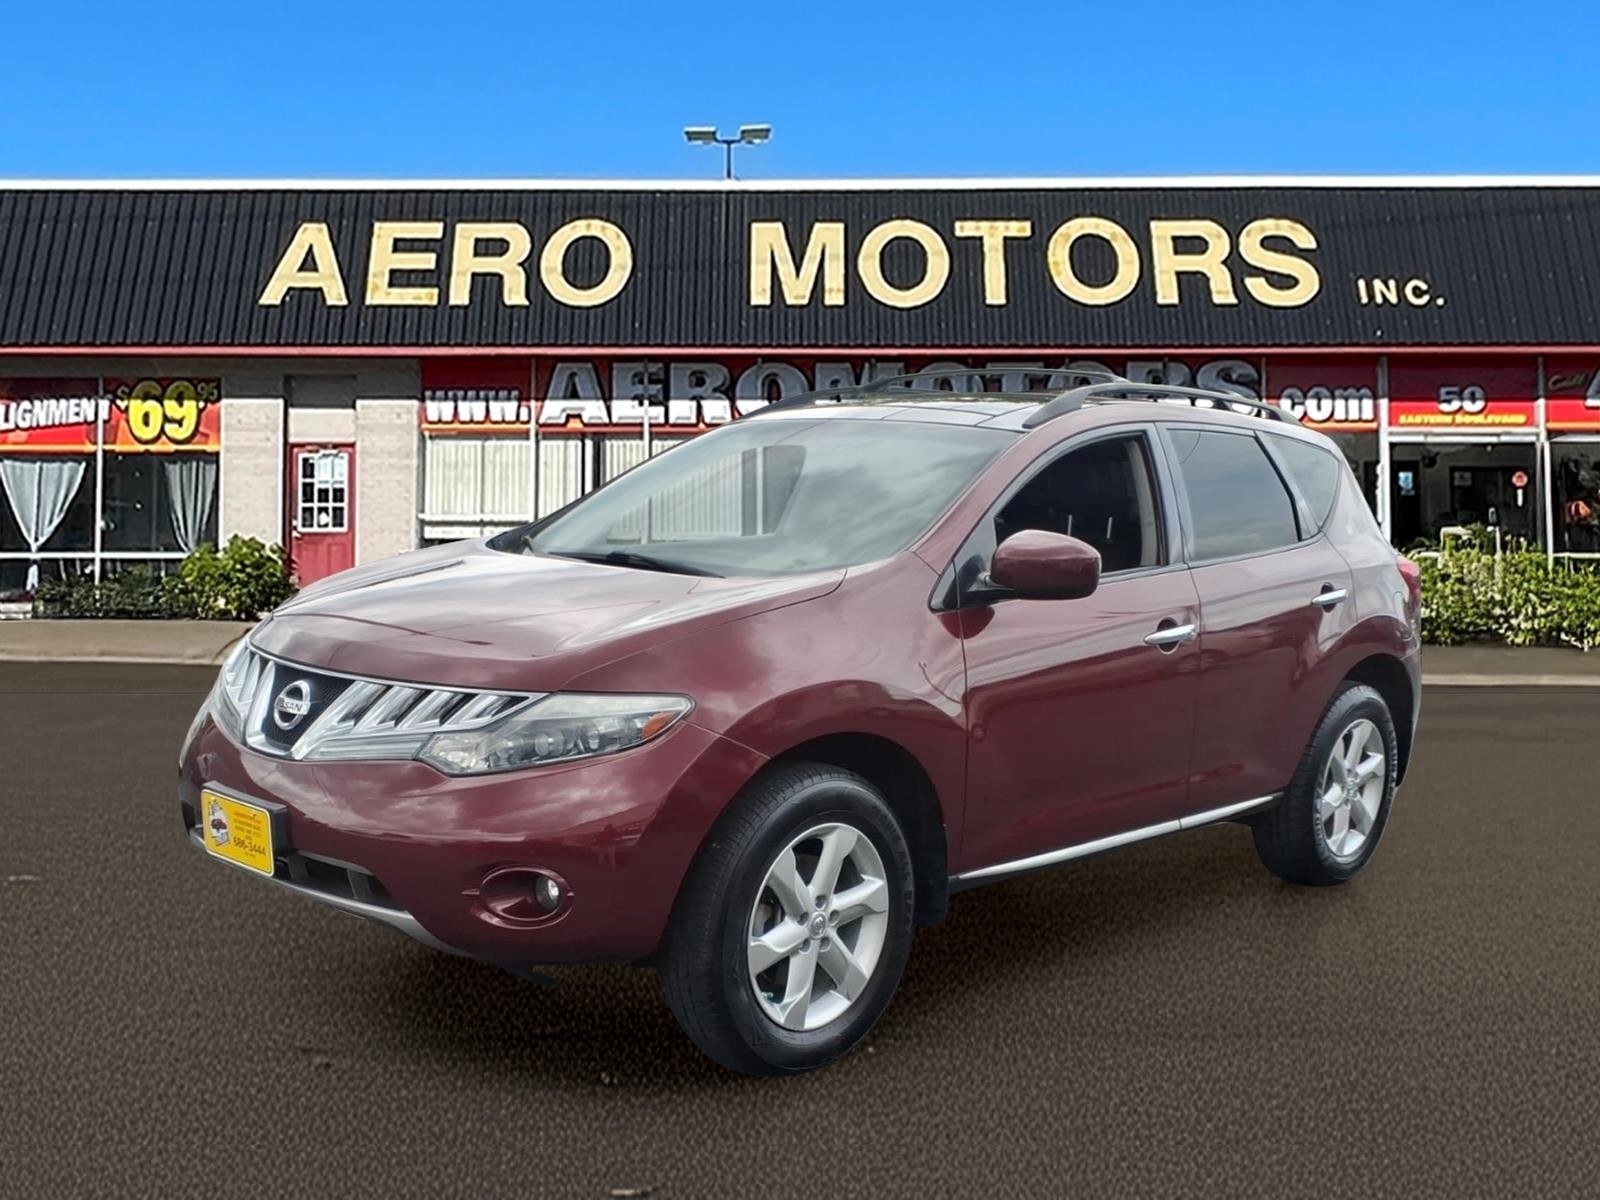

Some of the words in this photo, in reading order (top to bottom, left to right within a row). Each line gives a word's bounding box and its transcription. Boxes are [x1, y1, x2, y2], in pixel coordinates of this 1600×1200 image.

[258, 218, 633, 308] AERO
[749, 216, 1320, 308] MOTORS
[1356, 278, 1446, 306] INC.
[1436, 386, 1487, 413] 50
